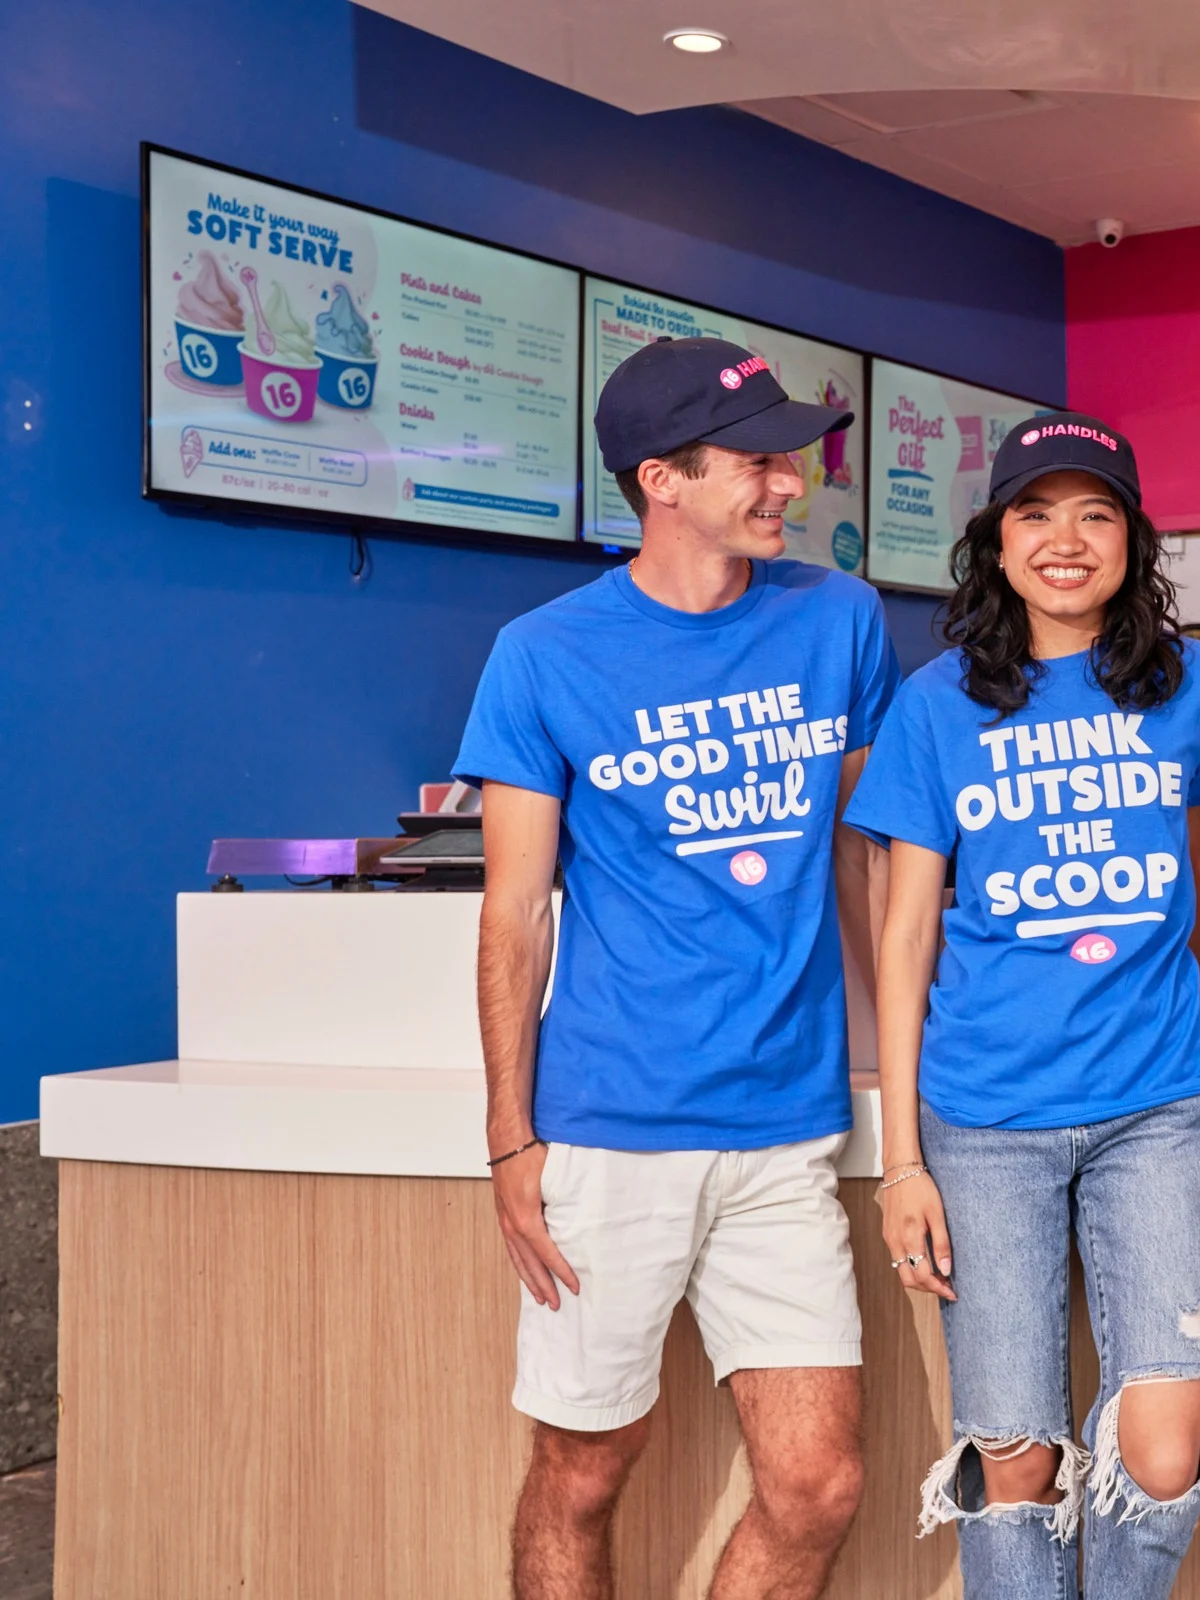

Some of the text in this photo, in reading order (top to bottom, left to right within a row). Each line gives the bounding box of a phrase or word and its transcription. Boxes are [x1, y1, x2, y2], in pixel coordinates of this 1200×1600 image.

[207, 192, 340, 244] Make it your way
[187, 209, 353, 274] SOFT SERVE
[616, 306, 649, 326] MADE
[651, 315, 666, 330] TO
[667, 320, 702, 338] ORDER
[185, 343, 213, 369] 16
[400, 343, 434, 362] Cookie
[437, 350, 472, 371] Dough
[265, 382, 297, 410] 16
[342, 375, 366, 399] 16
[888, 408, 945, 443] Perfect
[1042, 423, 1118, 451] HANDLES
[208, 441, 231, 456] Add
[897, 442, 926, 472] Gift
[886, 497, 934, 517] OCCASION
[891, 482, 930, 501] FOR ANY
[634, 683, 805, 745] LET THE
[588, 714, 849, 791] GOOD TIMES
[979, 712, 1153, 772] THINK
[664, 760, 811, 835] Swirl
[955, 761, 1183, 831] OUTSIDE
[1038, 818, 1116, 857] THE
[733, 856, 764, 880] 16
[985, 852, 1179, 916] SCOOP
[1075, 941, 1111, 960] 16
